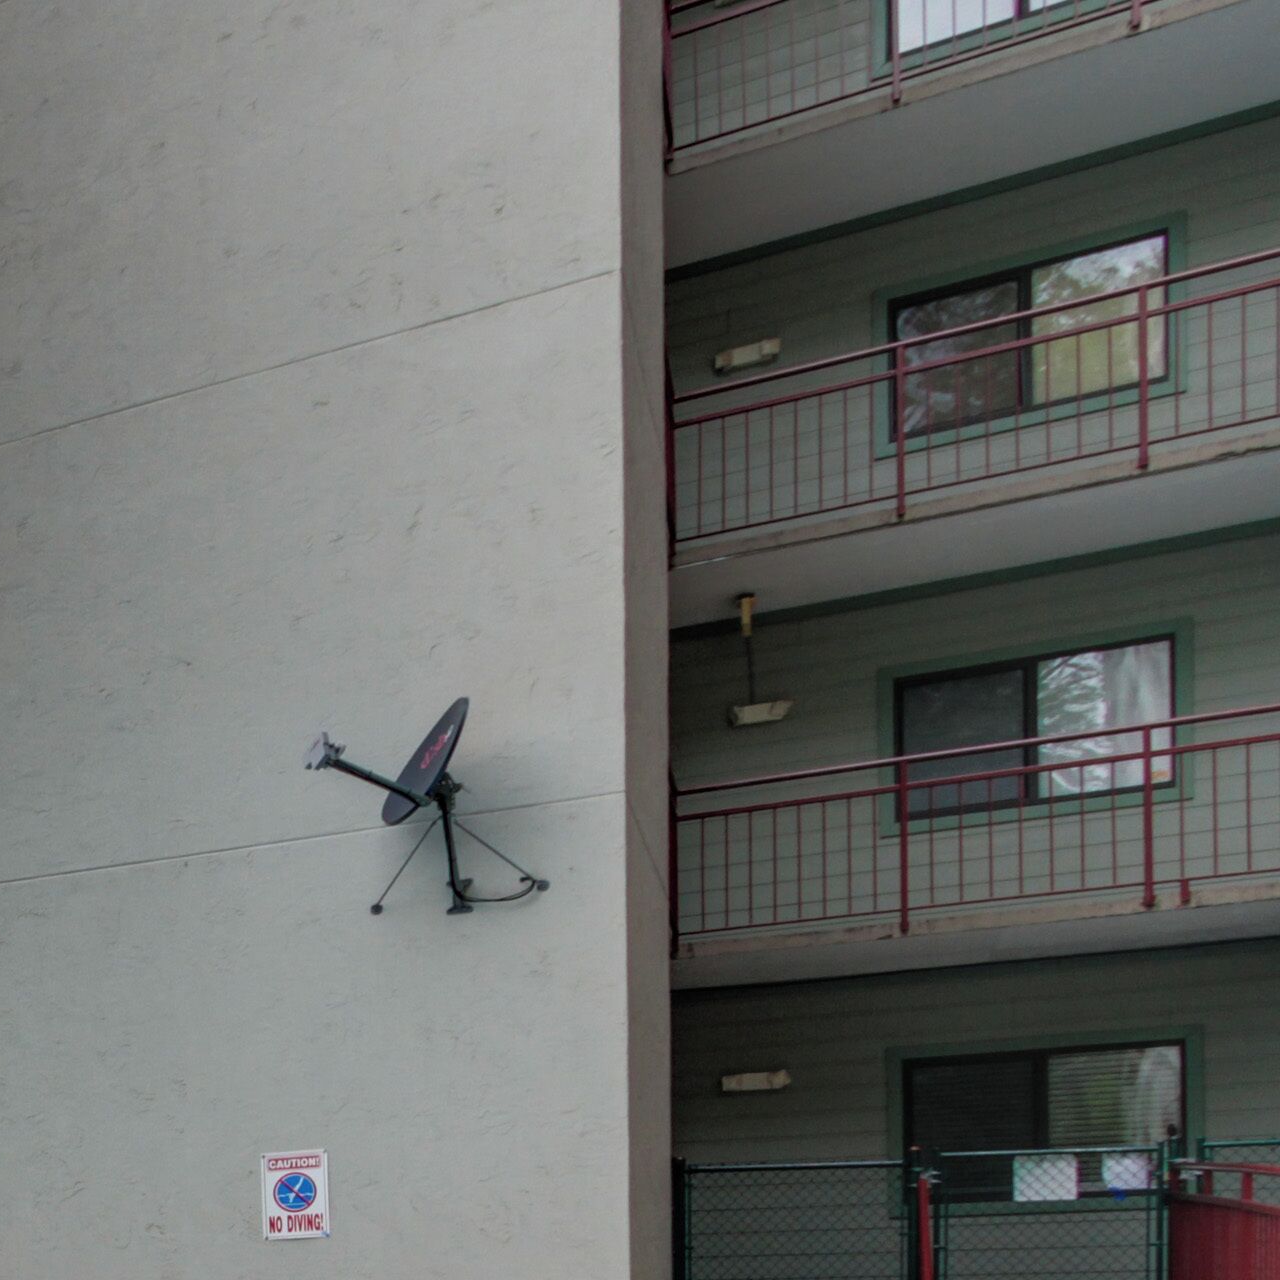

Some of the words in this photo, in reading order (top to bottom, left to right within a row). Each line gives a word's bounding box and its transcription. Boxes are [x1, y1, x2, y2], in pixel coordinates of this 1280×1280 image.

[269, 1157, 320, 1169] CAUTION!
[269, 1215, 283, 1233] NO
[287, 1213, 324, 1232] DIVING!
